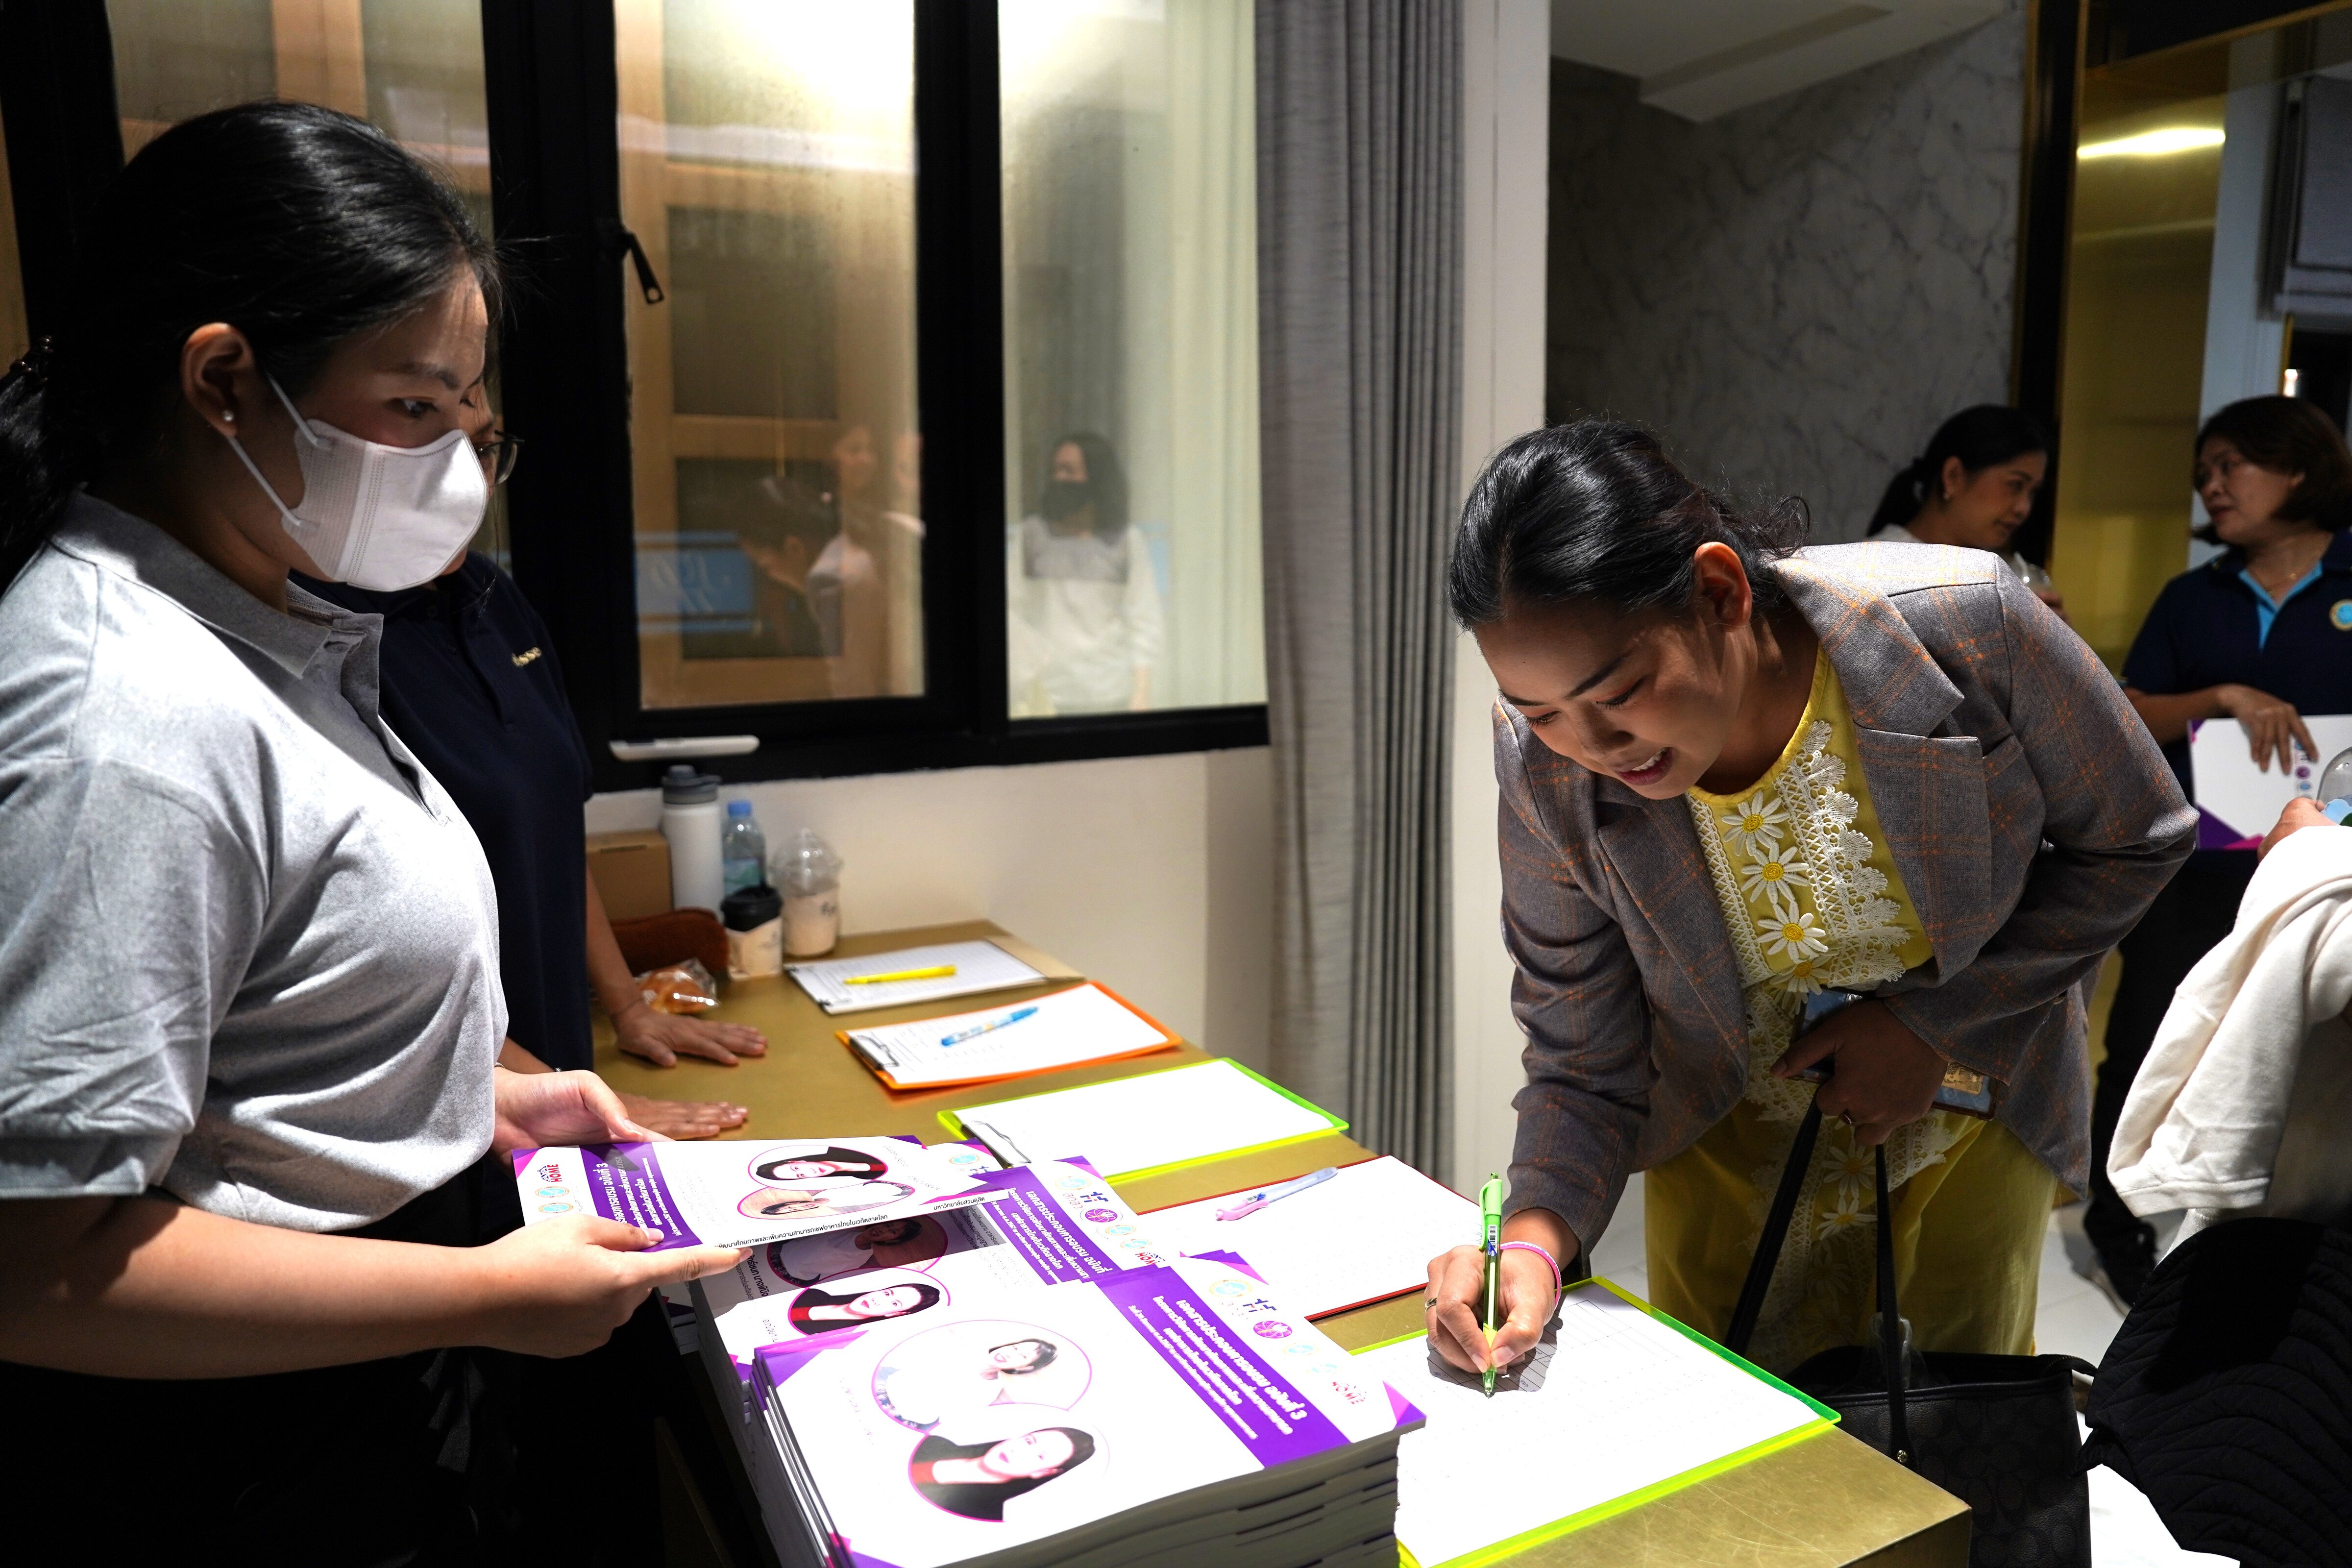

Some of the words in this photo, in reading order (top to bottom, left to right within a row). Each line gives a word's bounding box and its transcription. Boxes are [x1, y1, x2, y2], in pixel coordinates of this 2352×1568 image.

[547, 1164, 563, 1182] HOME
[593, 1168, 613, 1186] ฉบับที่
[605, 1186, 627, 1224] ระกอบการอบรม
[714, 1214, 888, 1249] พัฒนาศักยภาพและเพิ่มความสามารถเชฟอาหารไทยในเวทีตลาดโลก
[933, 1197, 985, 1210] มหาวิทยาลัยสวนดุสิต
[1026, 1191, 1089, 1257] เอกสารประกอบการอบรม
[1084, 1255, 1113, 1274] ฉบับที่
[1135, 1252, 1157, 1265] HOM
[1290, 1409, 1308, 1421] 3
